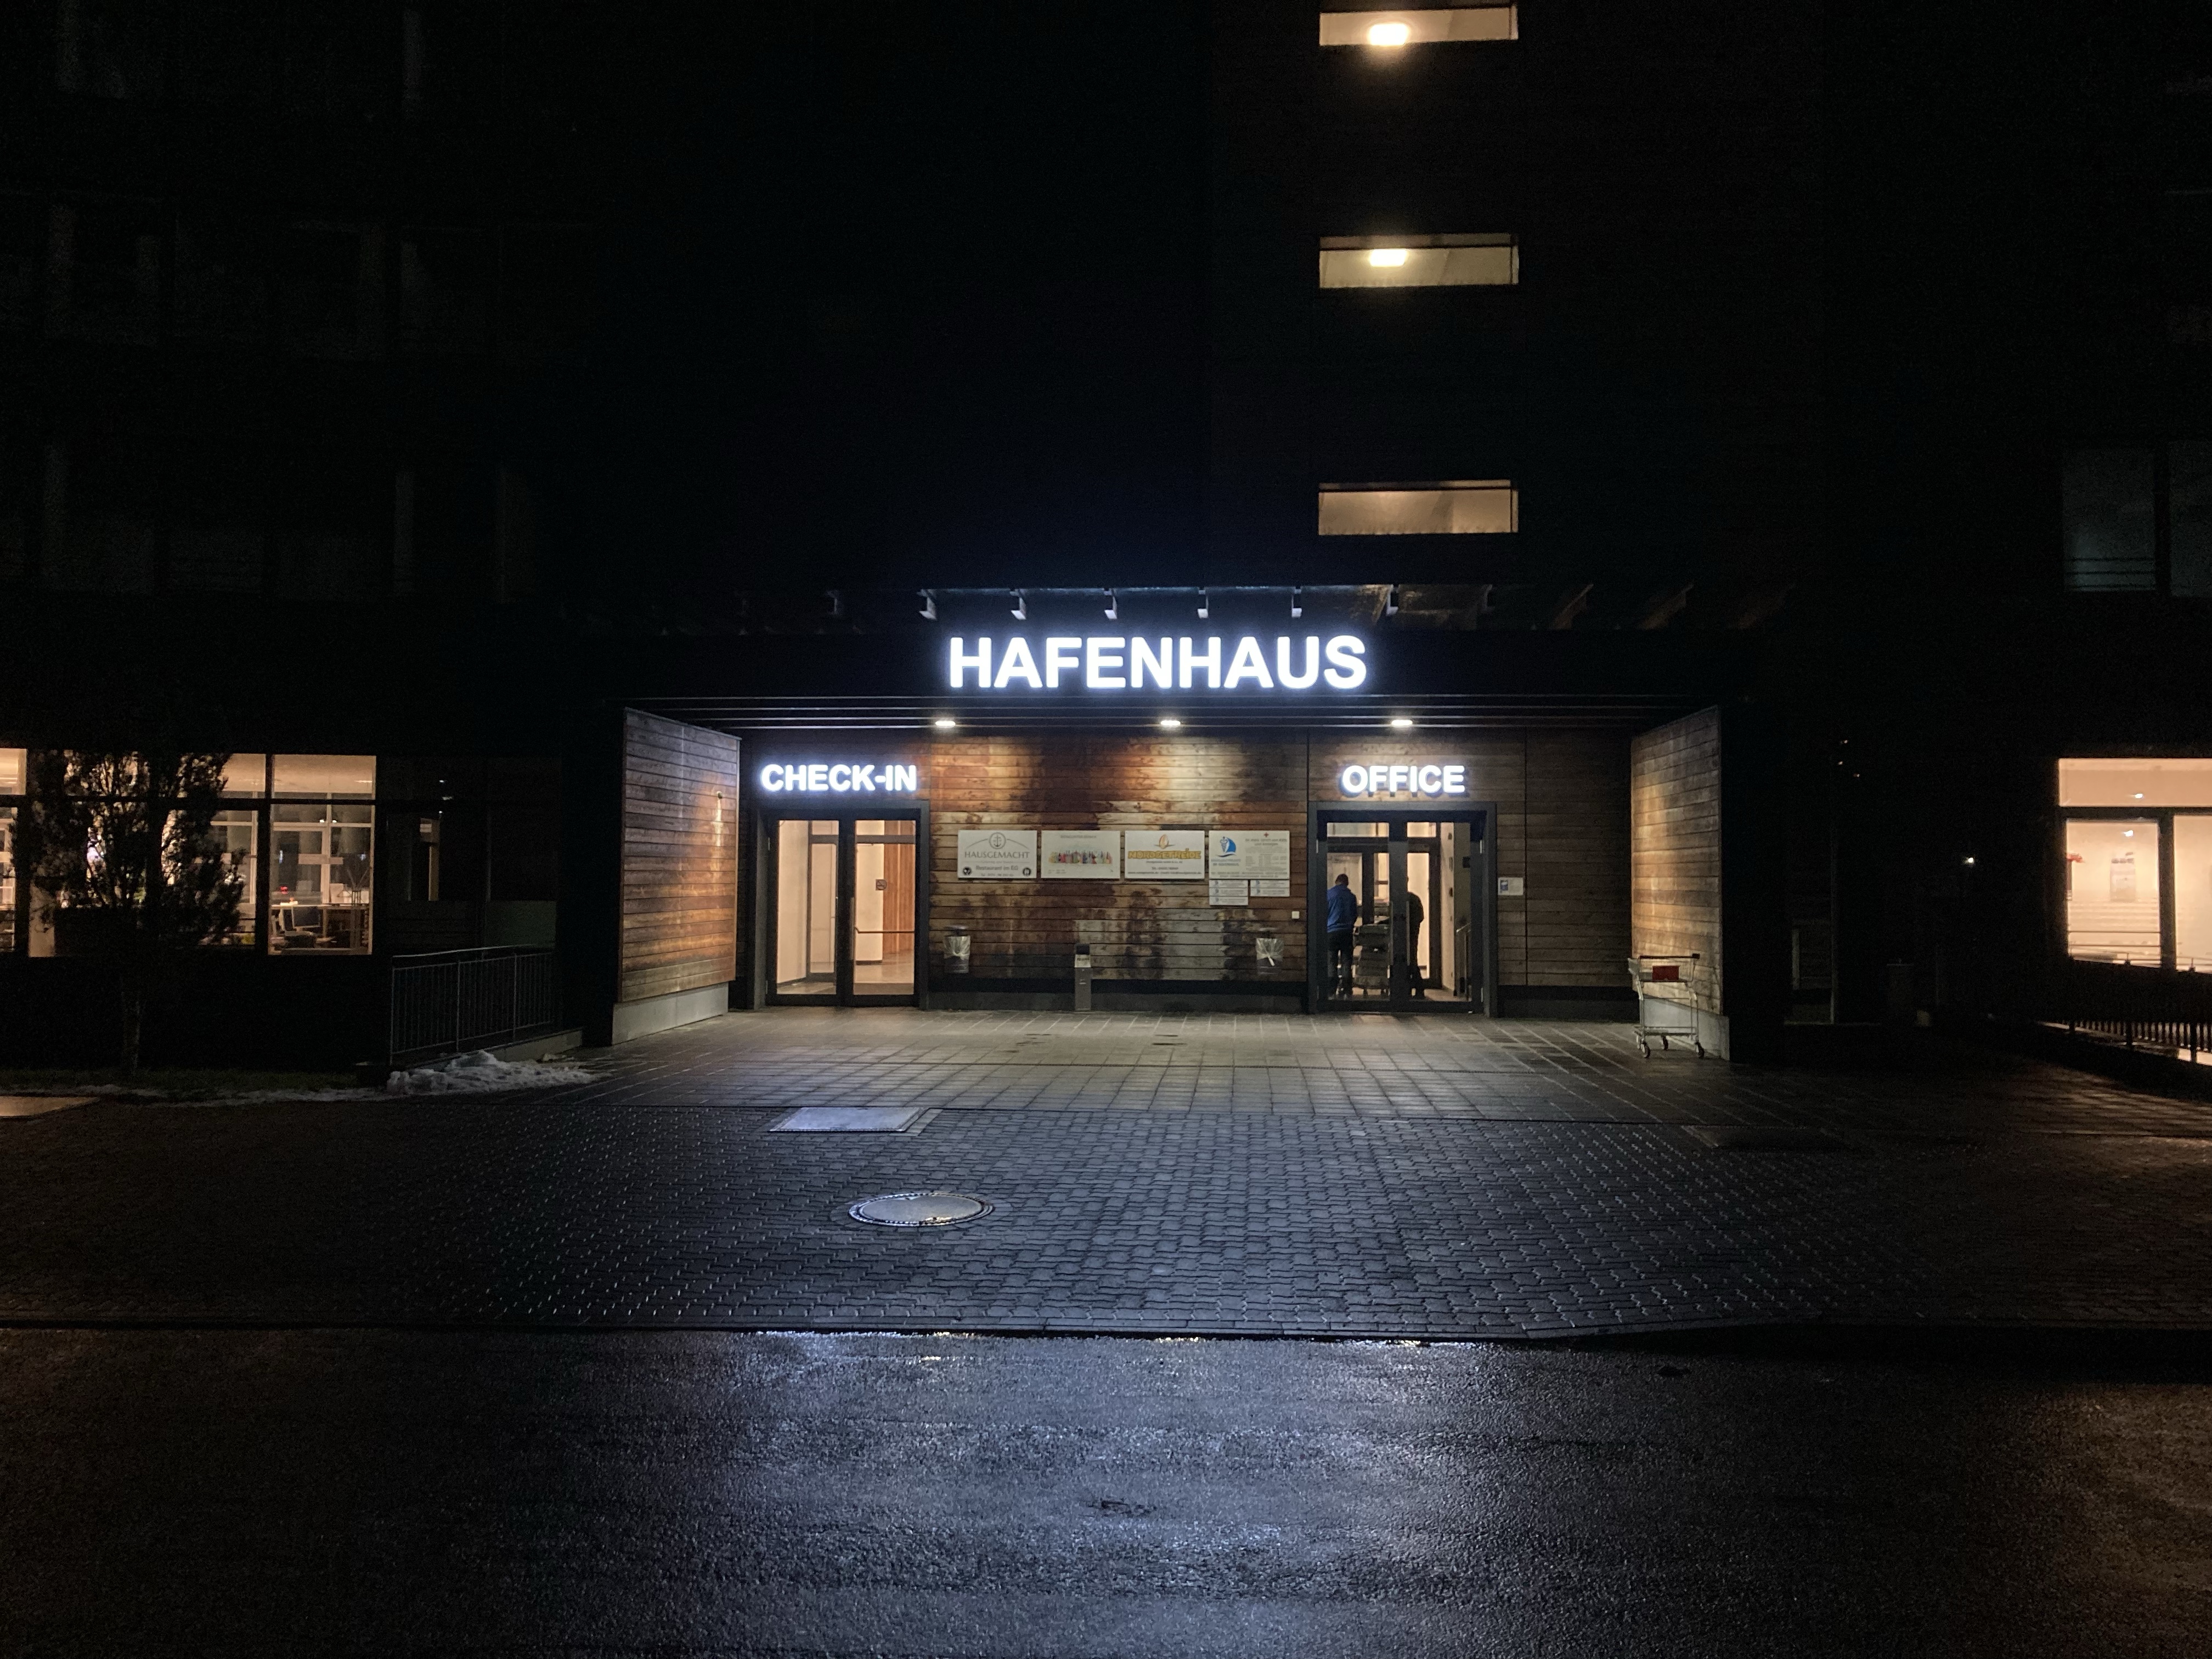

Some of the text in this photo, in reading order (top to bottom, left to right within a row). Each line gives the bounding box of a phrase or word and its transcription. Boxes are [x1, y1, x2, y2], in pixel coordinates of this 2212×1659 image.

[950, 635, 1367, 689] HAFENHAUS
[761, 764, 917, 791] CHECK-IN
[1342, 764, 1465, 793] OFFICE
